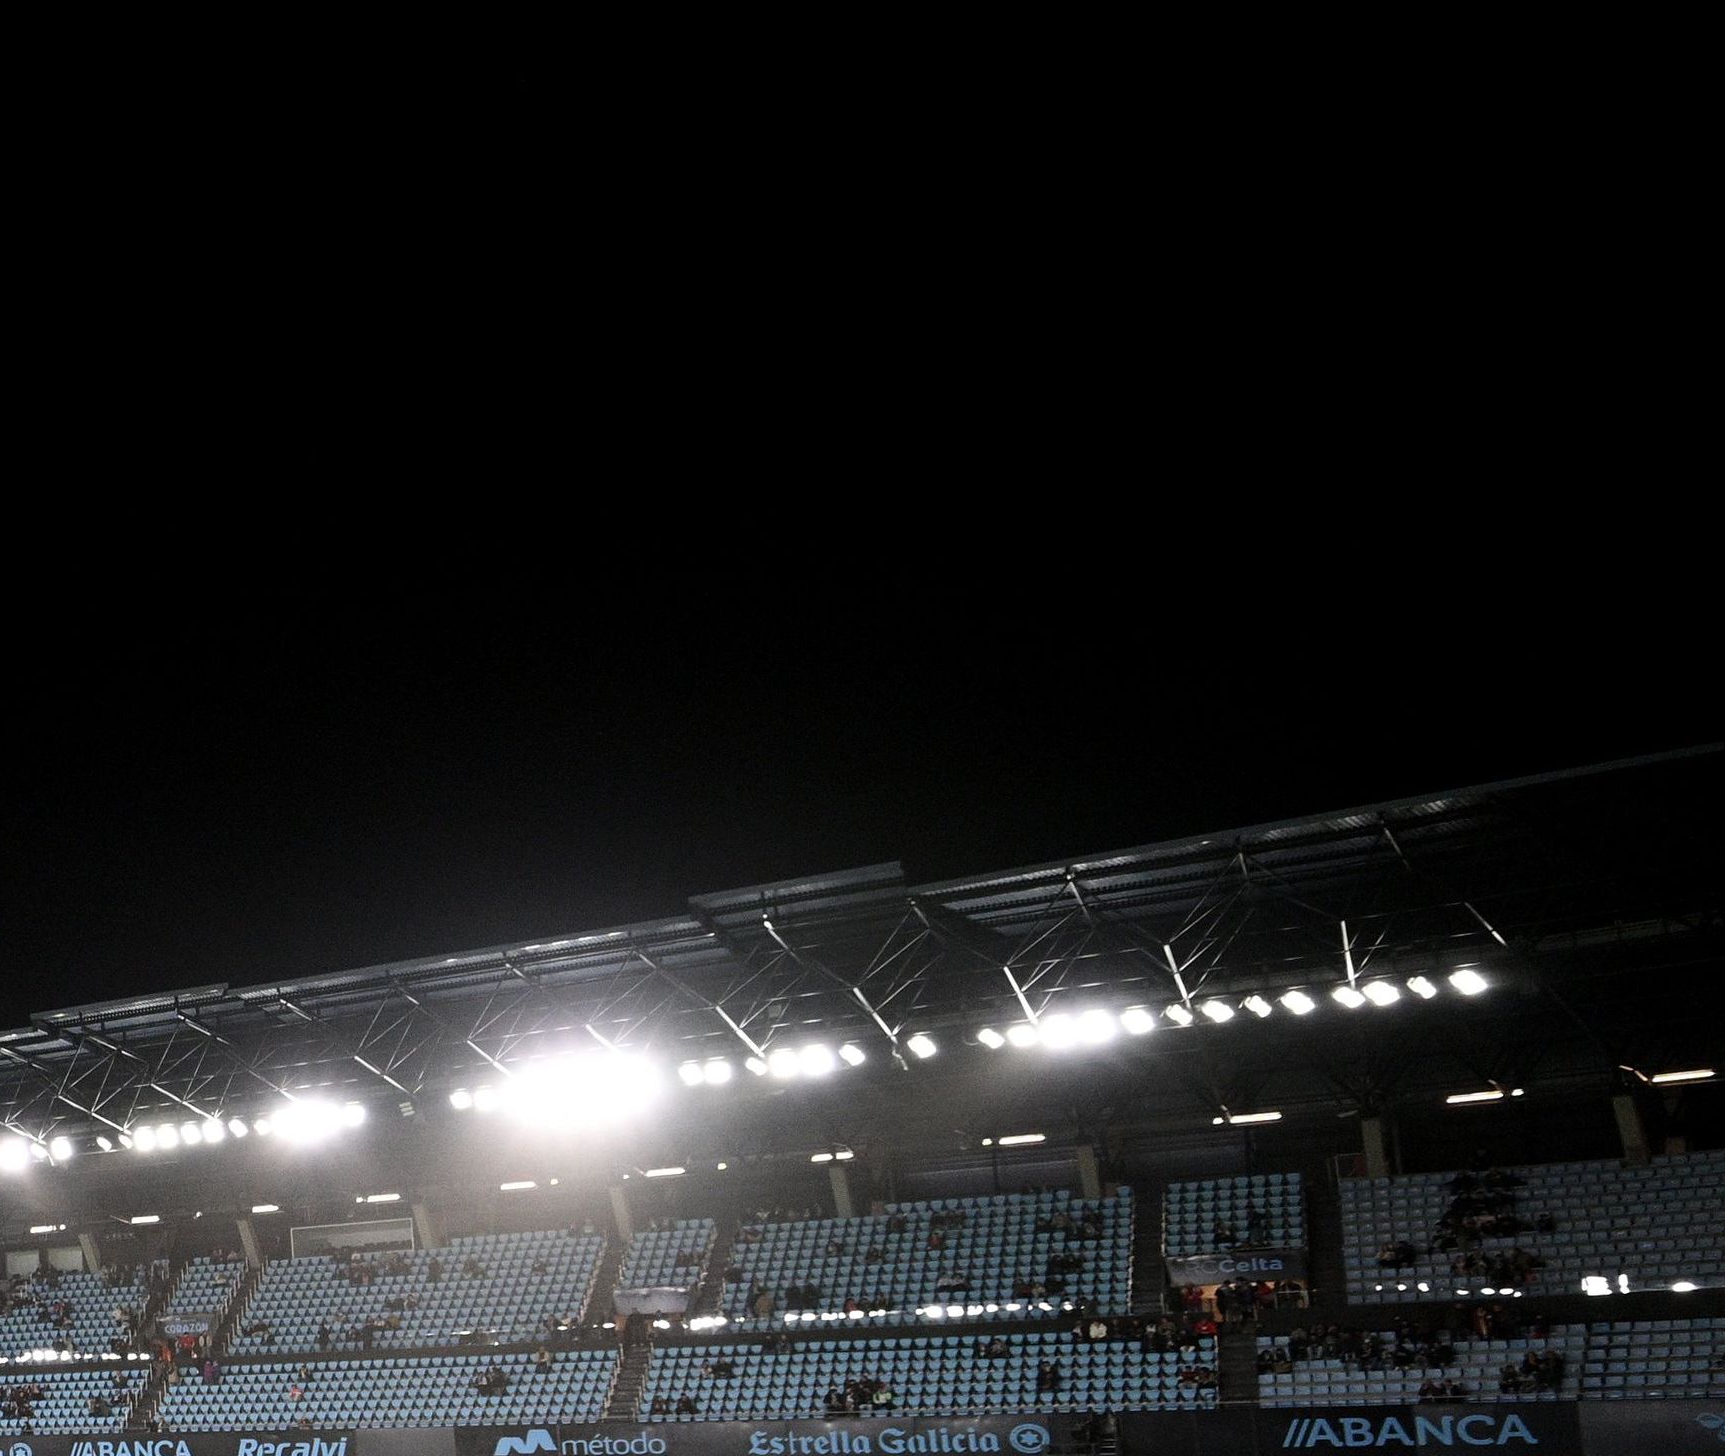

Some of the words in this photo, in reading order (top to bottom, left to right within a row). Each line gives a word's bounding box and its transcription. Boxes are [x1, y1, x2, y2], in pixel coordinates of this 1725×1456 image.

[561, 1430, 666, 1456] método
[749, 1430, 871, 1455] Estrella
[879, 1427, 1000, 1454] Galicia
[1305, 1413, 1538, 1448] ABANCA
